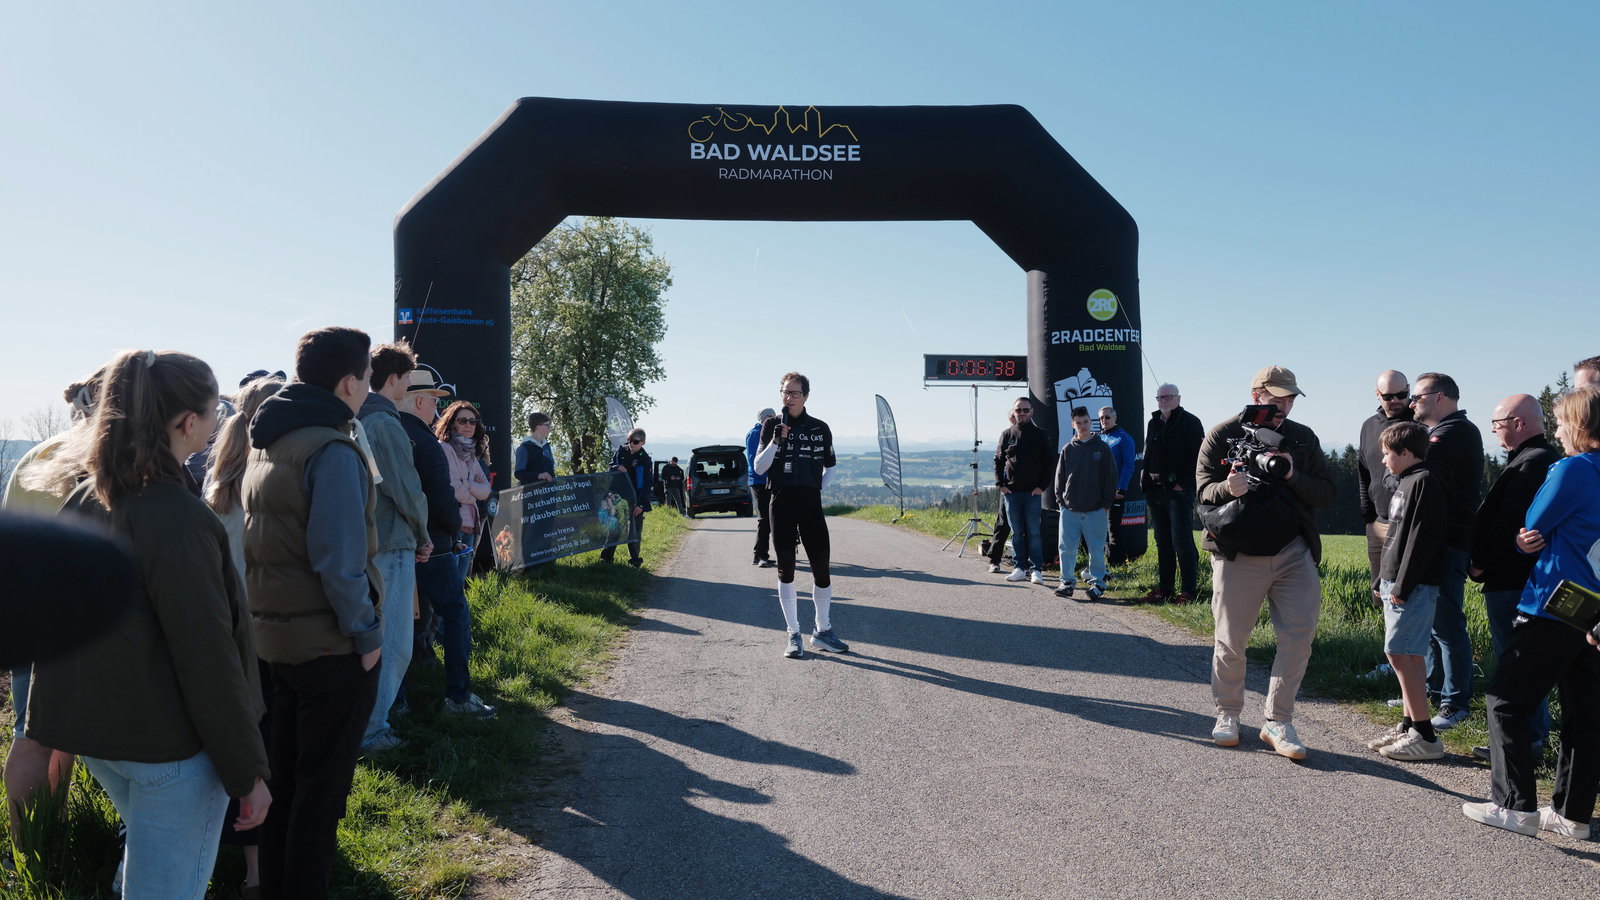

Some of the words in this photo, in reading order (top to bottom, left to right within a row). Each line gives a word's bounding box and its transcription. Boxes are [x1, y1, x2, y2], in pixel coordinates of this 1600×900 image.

[690, 144, 740, 160] BAD
[748, 144, 861, 162] WALDSEE
[719, 168, 832, 180] RADMARATHON
[416, 308, 473, 316] Raiffeisenbank
[416, 317, 484, 326] Reute-Gaisbeuren
[1051, 329, 1140, 344] 2RADCENTER
[948, 360, 1014, 376] 0:06:38
[521, 492, 533, 500] zum
[533, 482, 573, 496] Weltrekord,
[573, 480, 592, 489] Papa!
[535, 496, 562, 508] schaffst
[562, 493, 577, 501] das!
[530, 509, 561, 524] glauben
[572, 502, 590, 512] dich!
[558, 526, 575, 534] Irena
